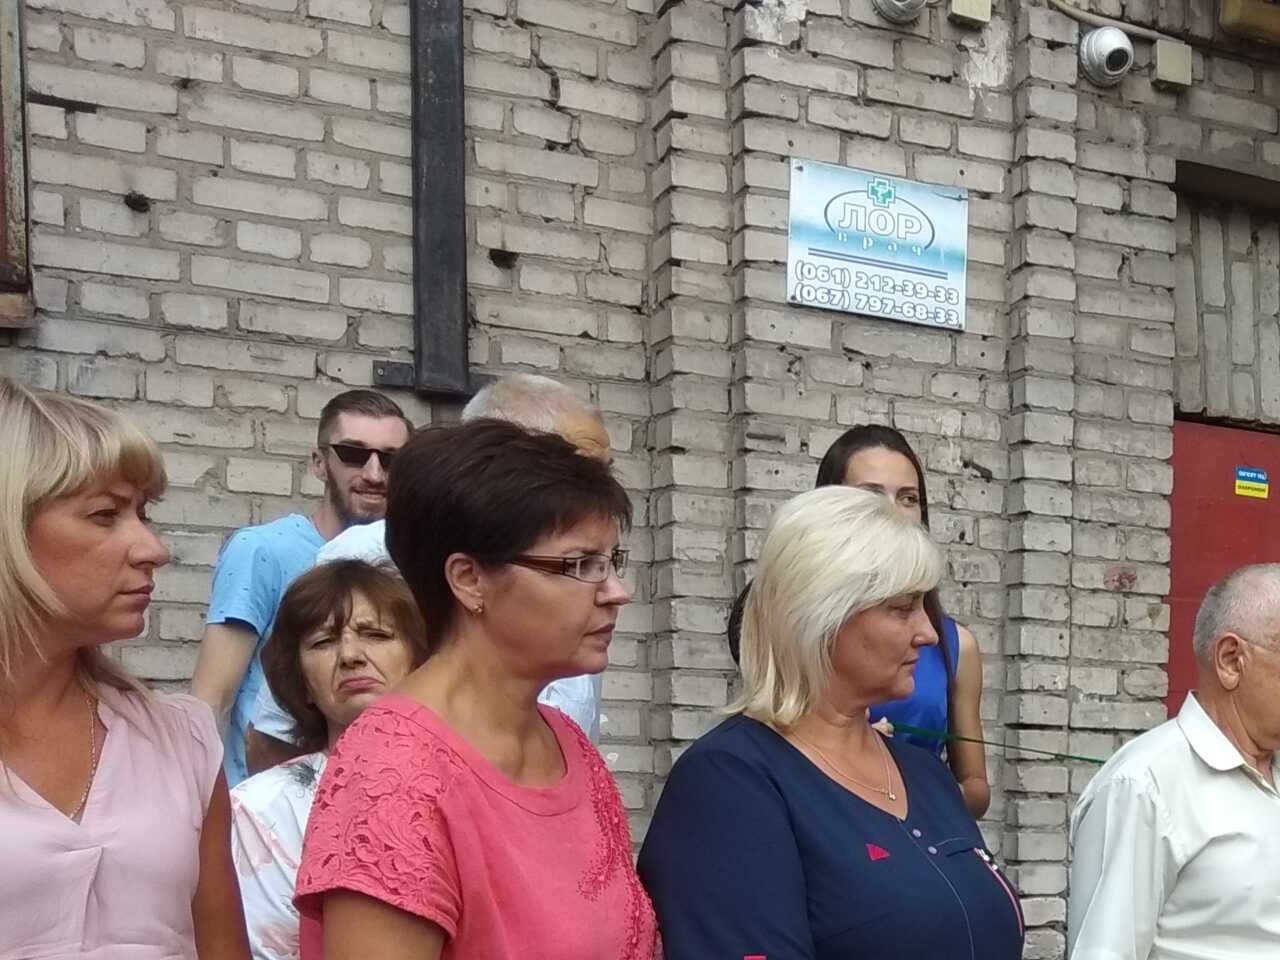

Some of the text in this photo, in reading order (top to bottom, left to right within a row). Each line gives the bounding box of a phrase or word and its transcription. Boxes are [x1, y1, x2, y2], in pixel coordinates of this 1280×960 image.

[839, 202, 922, 240] ЛОР
[795, 260, 959, 305] (061) 212-39-33
[795, 282, 959, 326] (067) 797-68-33
